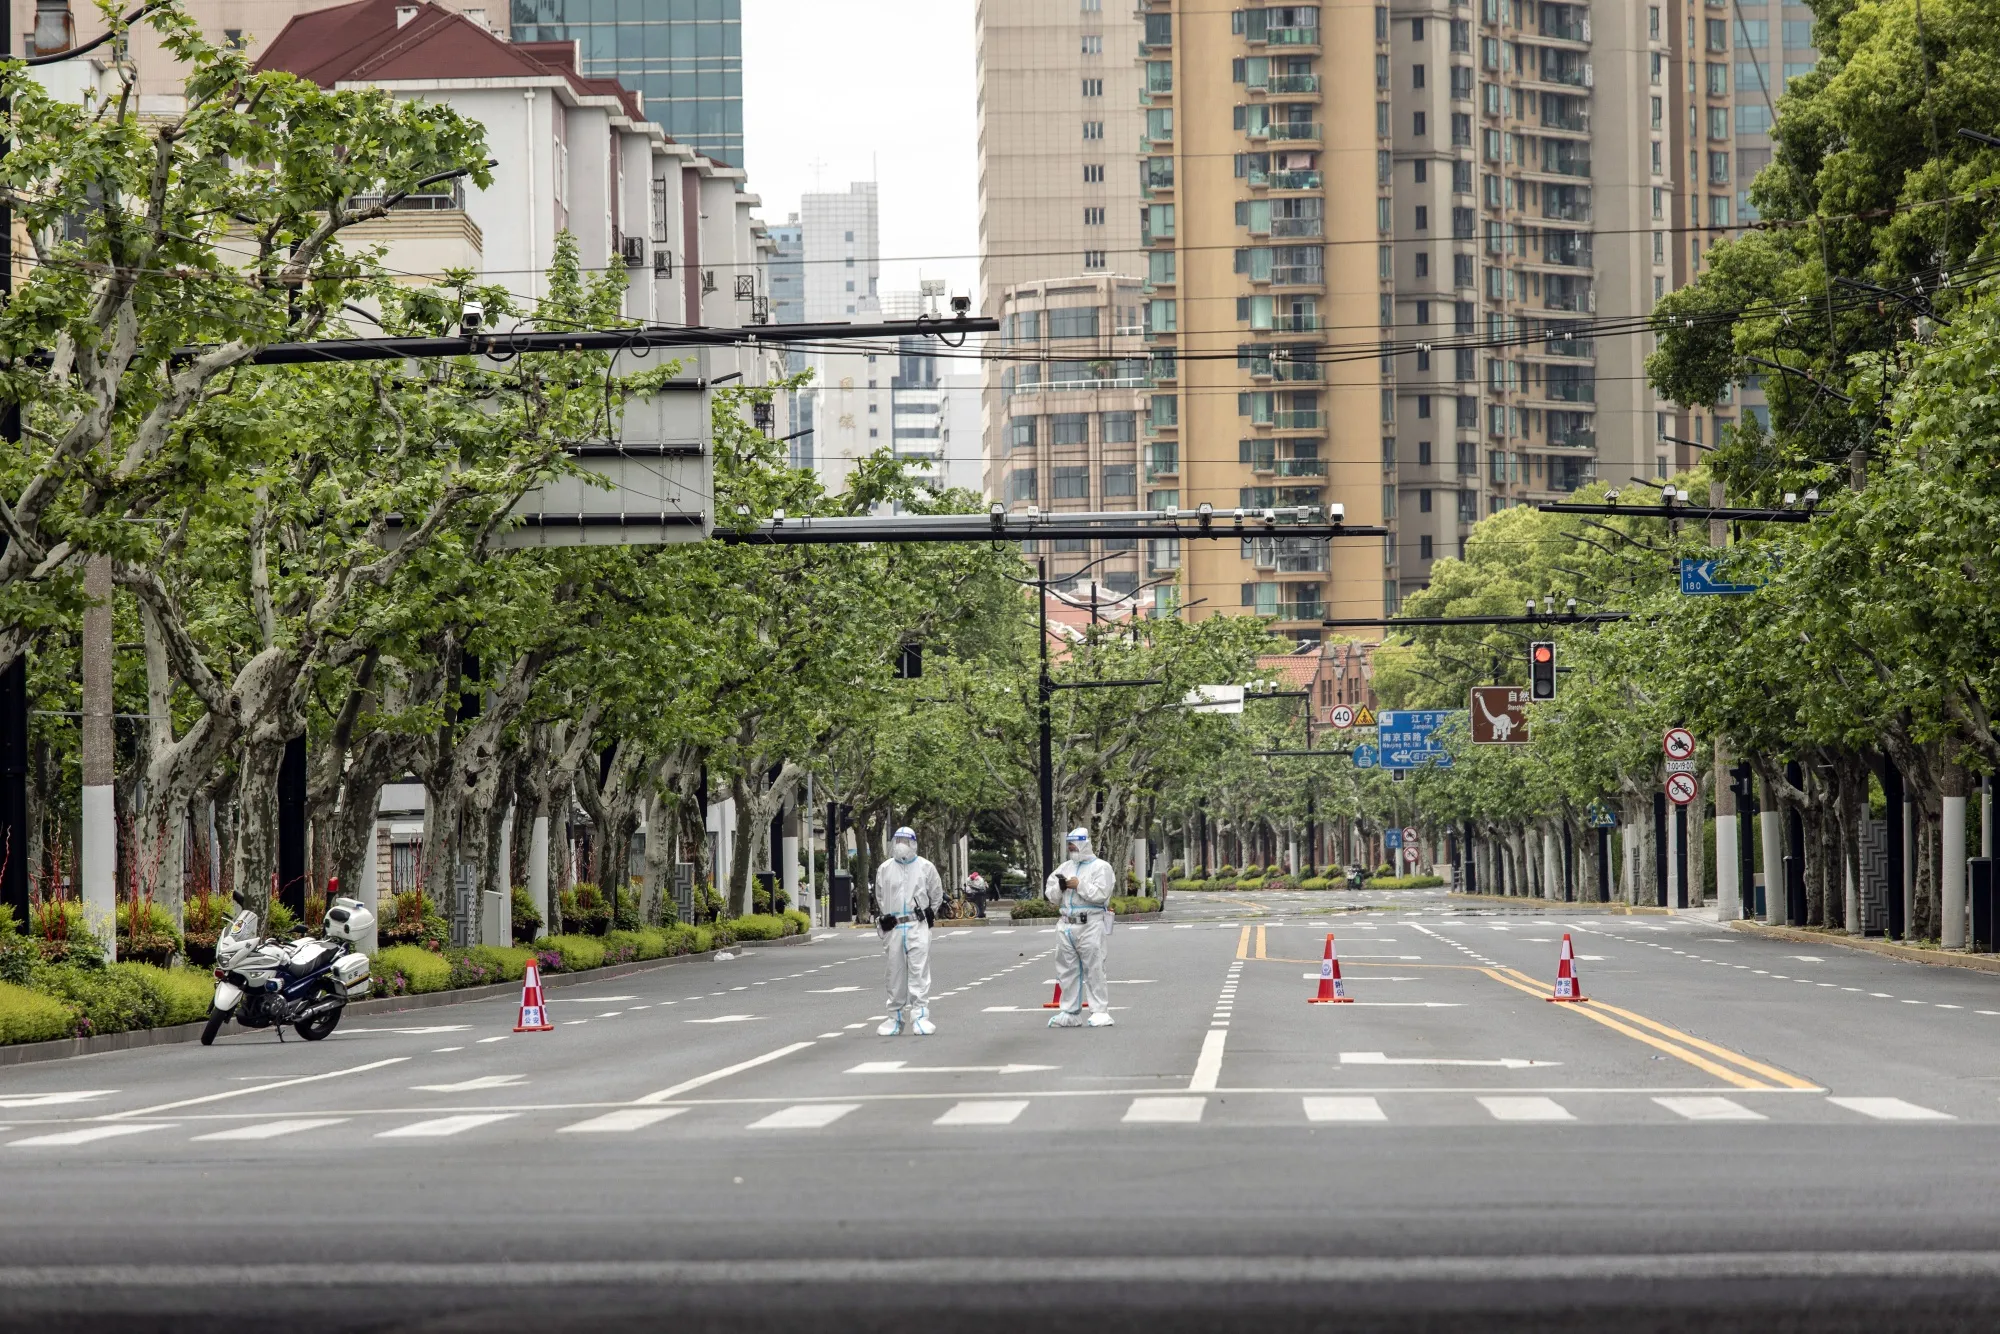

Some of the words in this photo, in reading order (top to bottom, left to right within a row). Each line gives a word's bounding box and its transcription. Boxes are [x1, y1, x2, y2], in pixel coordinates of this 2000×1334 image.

[1685, 582, 1701, 590] 180
[1508, 690, 1530, 702] 自然
[1335, 711, 1350, 721] 40
[1411, 714, 1445, 723] 江宁路
[1382, 732, 1421, 742] 南京西路
[1667, 762, 1694, 770] 7:00-19:00
[524, 1017, 539, 1025] 公安
